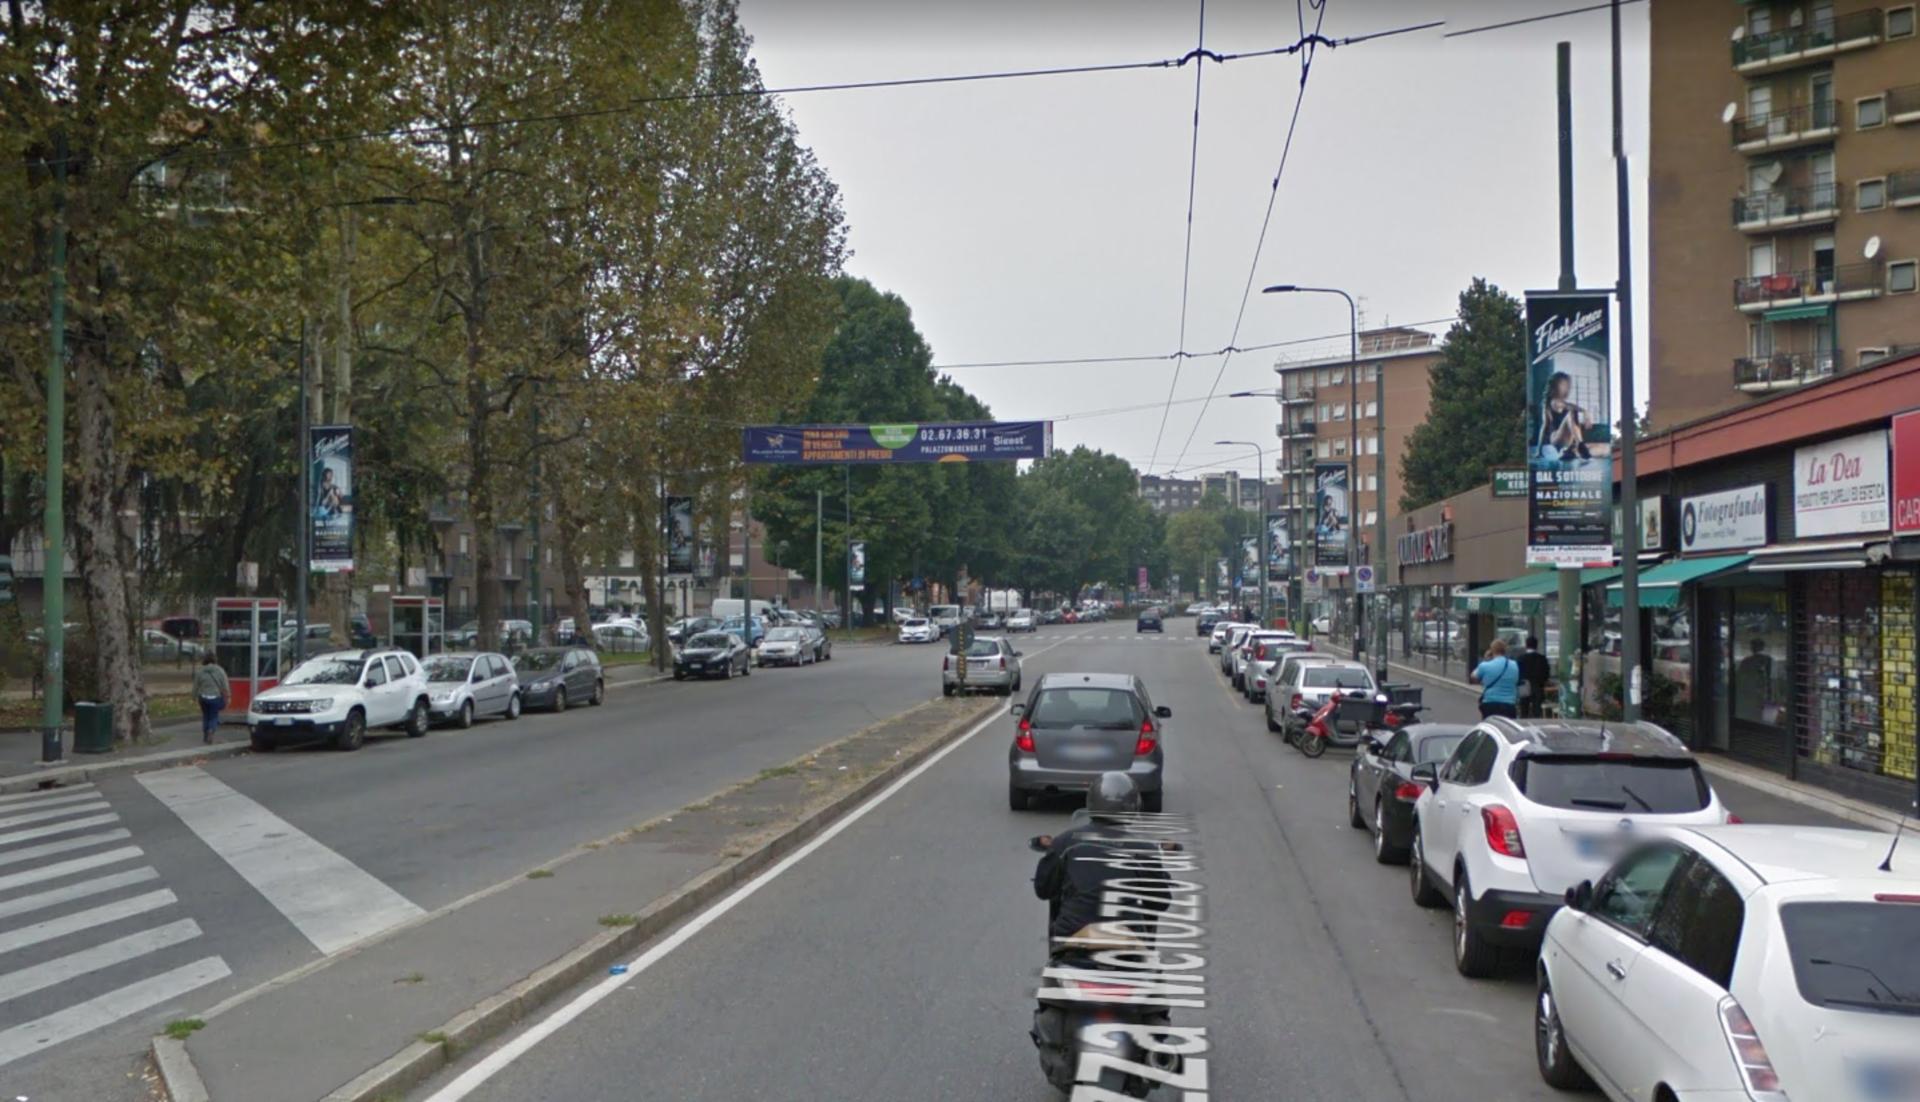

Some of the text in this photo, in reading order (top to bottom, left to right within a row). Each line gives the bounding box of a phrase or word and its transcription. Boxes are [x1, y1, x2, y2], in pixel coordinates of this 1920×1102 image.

[921, 427, 987, 441] 02.67.36.31
[1807, 452, 1862, 486] La Dea
[1536, 490, 1602, 500] NAZIONALE
[1698, 491, 1765, 526] Fotografando
